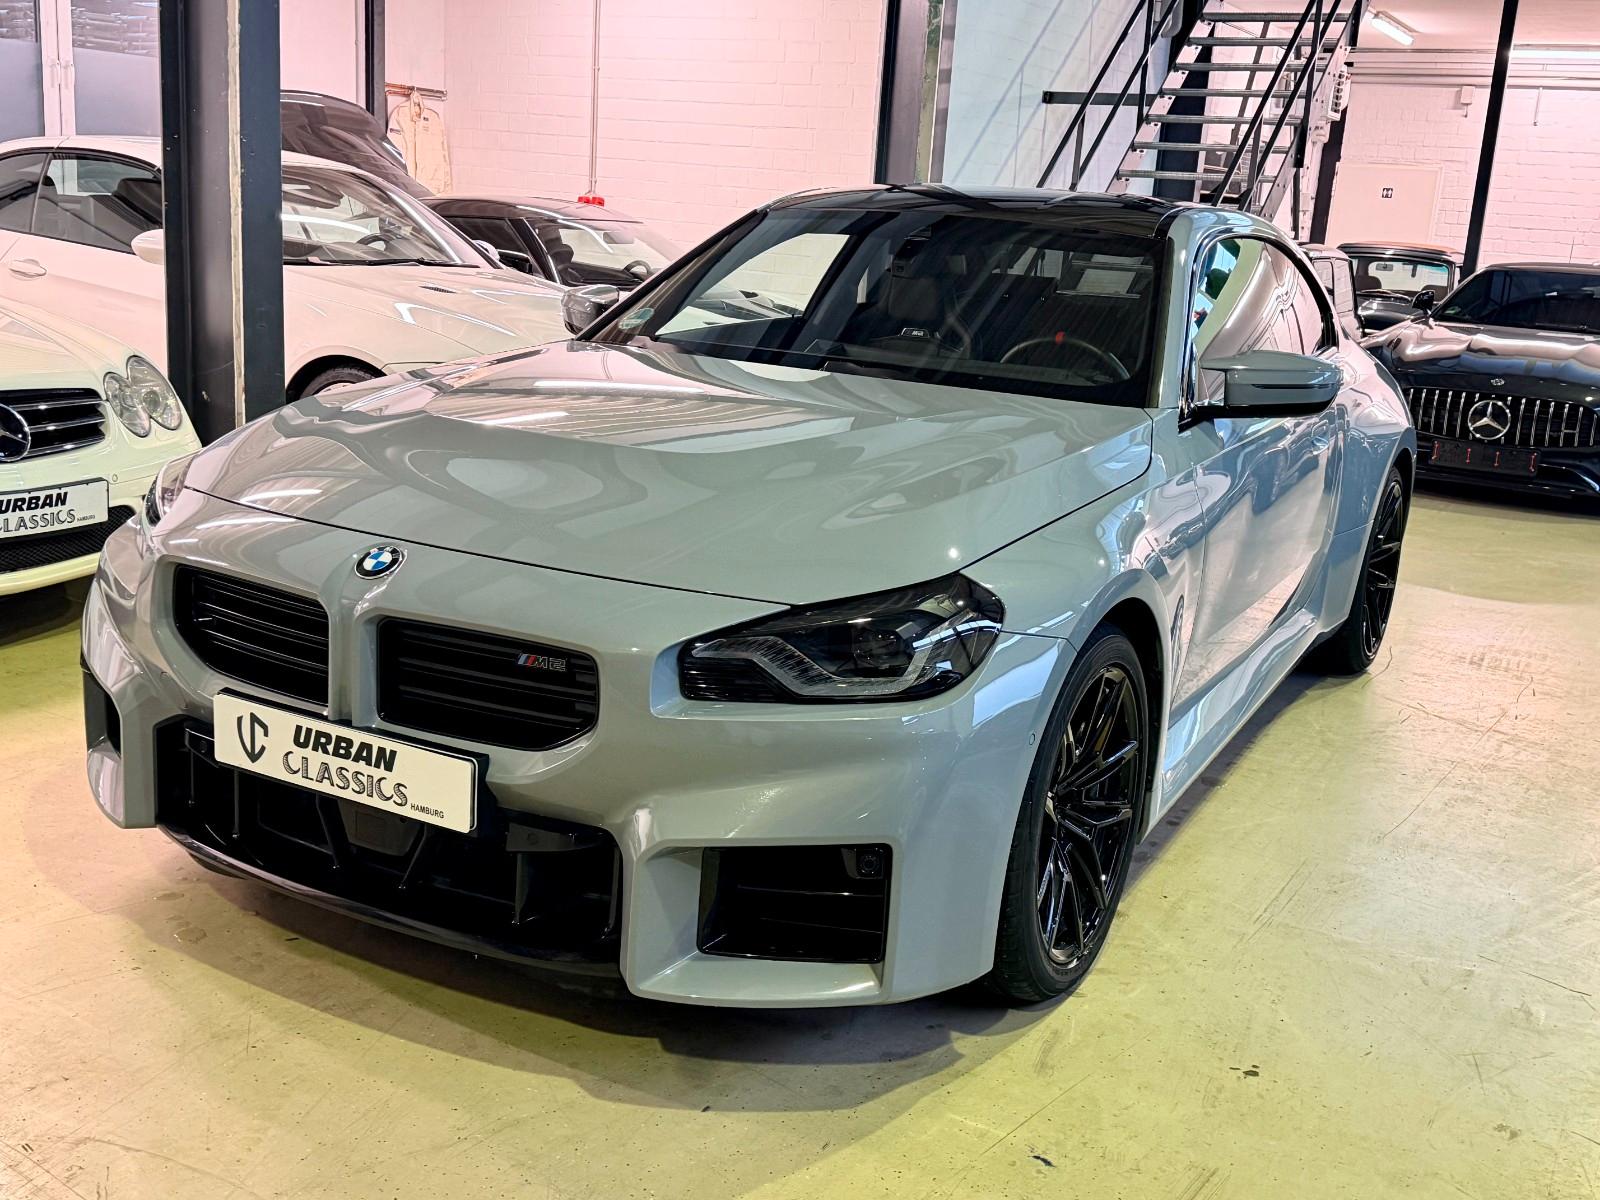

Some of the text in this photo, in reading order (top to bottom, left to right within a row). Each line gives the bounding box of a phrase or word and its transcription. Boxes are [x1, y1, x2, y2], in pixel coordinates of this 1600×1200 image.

[0, 492, 68, 514] URBAN
[0, 509, 76, 532] LASSICS
[293, 724, 397, 772] URBAN
[283, 750, 408, 807] CLASSICS
[410, 803, 445, 819] HAMBURG
